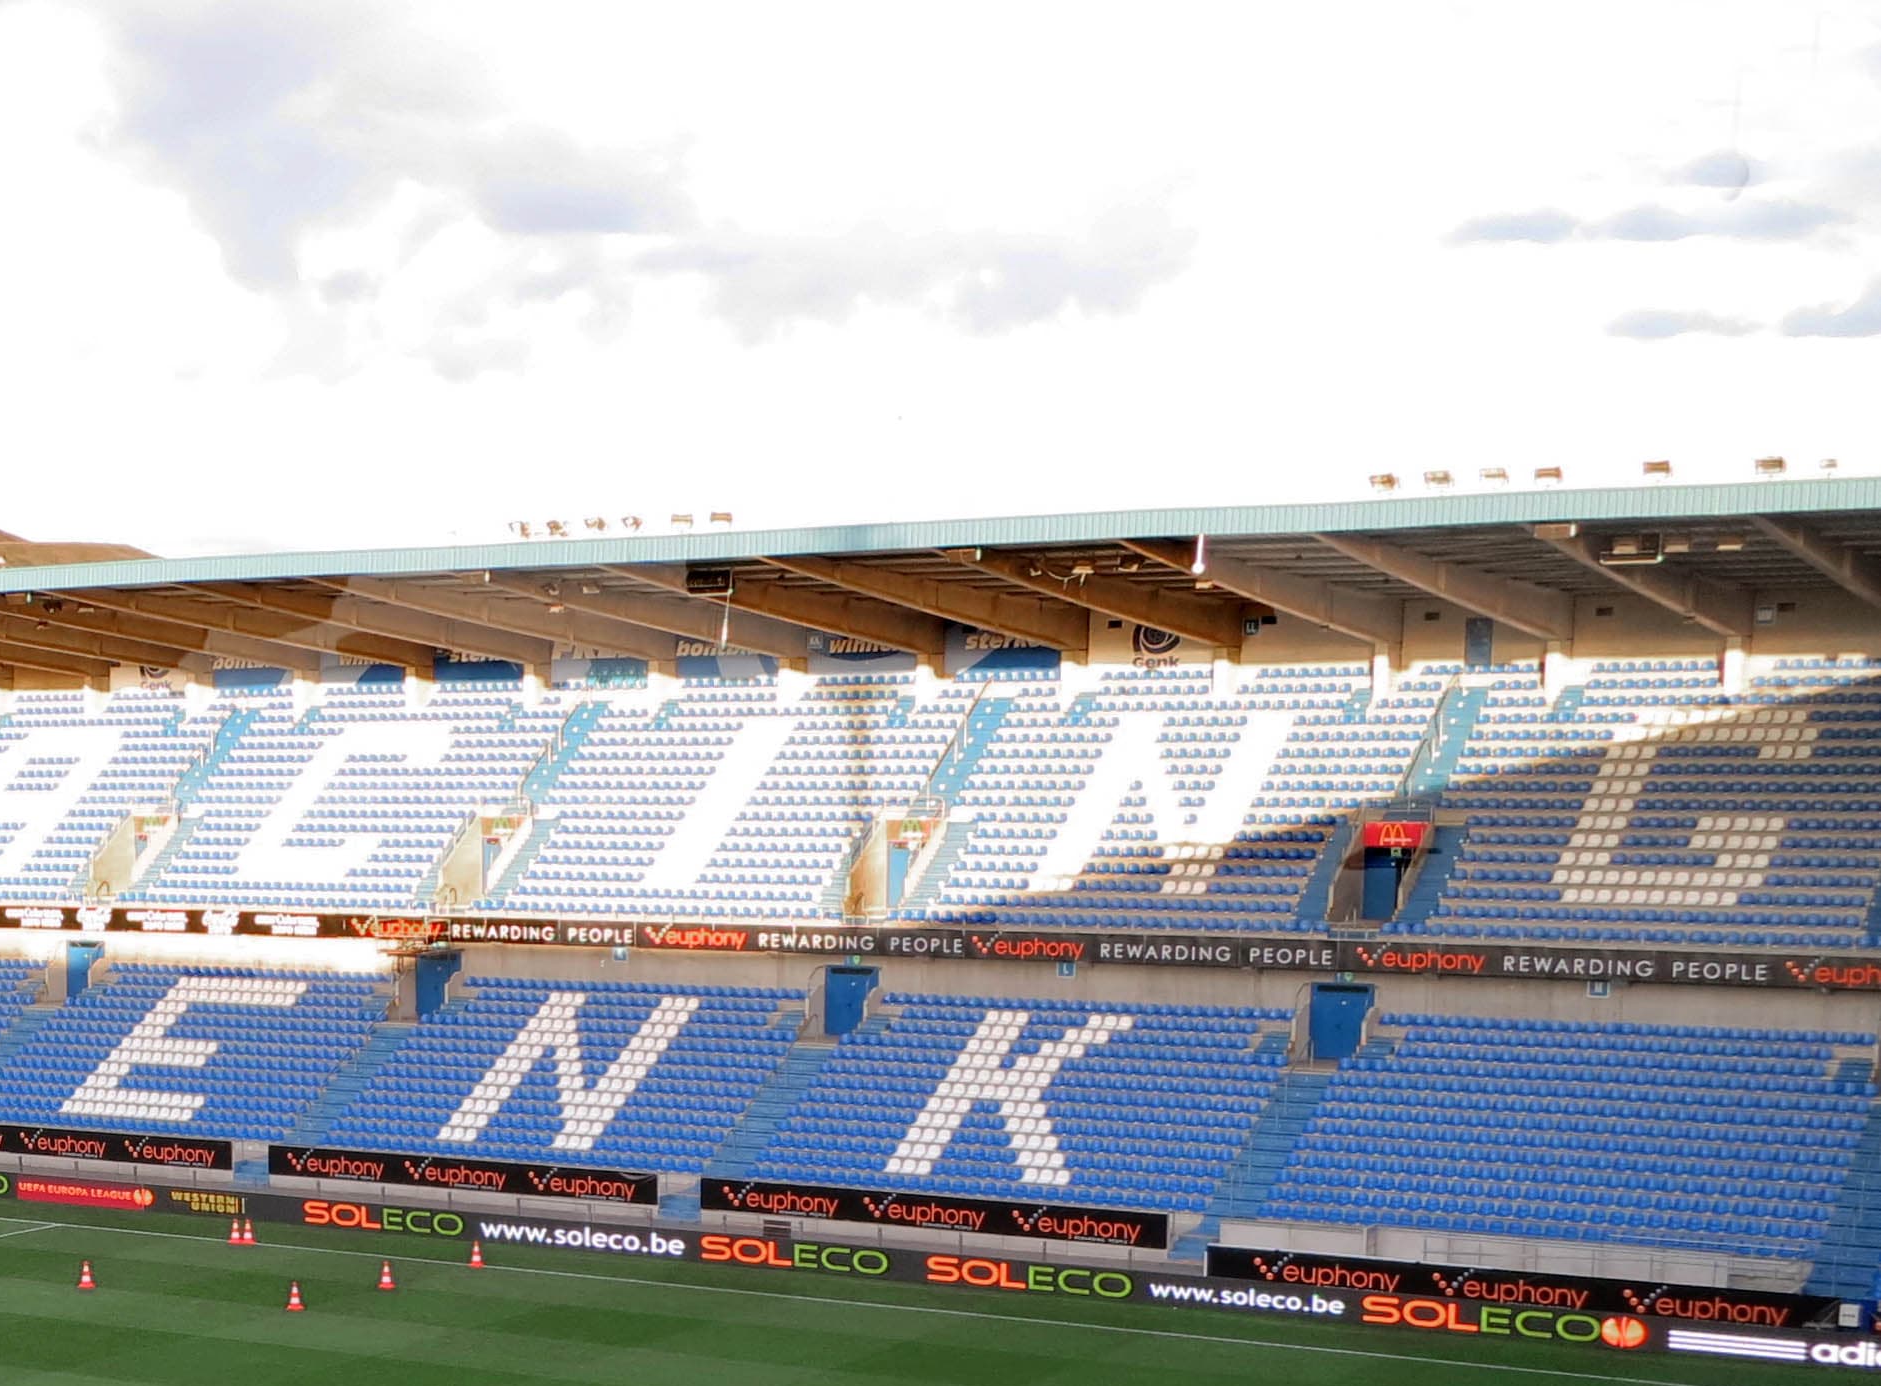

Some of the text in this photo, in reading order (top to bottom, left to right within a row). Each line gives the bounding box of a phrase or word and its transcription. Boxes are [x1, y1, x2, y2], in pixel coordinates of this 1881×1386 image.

[1133, 656, 1179, 669] Genk
[452, 923, 633, 943] REWARDING PEOPLE
[666, 925, 747, 950] euphony
[758, 932, 963, 954] REWARDING PEOPLE
[994, 938, 1084, 961] euphony
[1100, 942, 1333, 965] REWARDING PEOPLE
[1382, 949, 1485, 974] euphony
[1503, 956, 1767, 981] REWARDING PEOPLE
[38, 1135, 106, 1159] euphony
[143, 1142, 215, 1168] euphony
[307, 1154, 384, 1181] euphony
[425, 1162, 506, 1190] euphony
[20, 1182, 132, 1200] UEFA EUROPA LEAGUE
[551, 1173, 635, 1201] euphony
[303, 1200, 464, 1236] SOLECO
[746, 1190, 839, 1219] euphony
[887, 1199, 985, 1231] euphony
[480, 1221, 685, 1256] www.soleco.be
[1038, 1213, 1141, 1244] euphony
[700, 1235, 889, 1275] SOLECO
[926, 1255, 1134, 1298] SOLECO
[1283, 1264, 1400, 1292] euphony
[1149, 1282, 1345, 1315] www.soleco.be
[1463, 1280, 1588, 1310] euphony
[1362, 1296, 1601, 1342] SOLECO
[1655, 1297, 1790, 1327] euphony
[1811, 1341, 1881, 1367] adi
